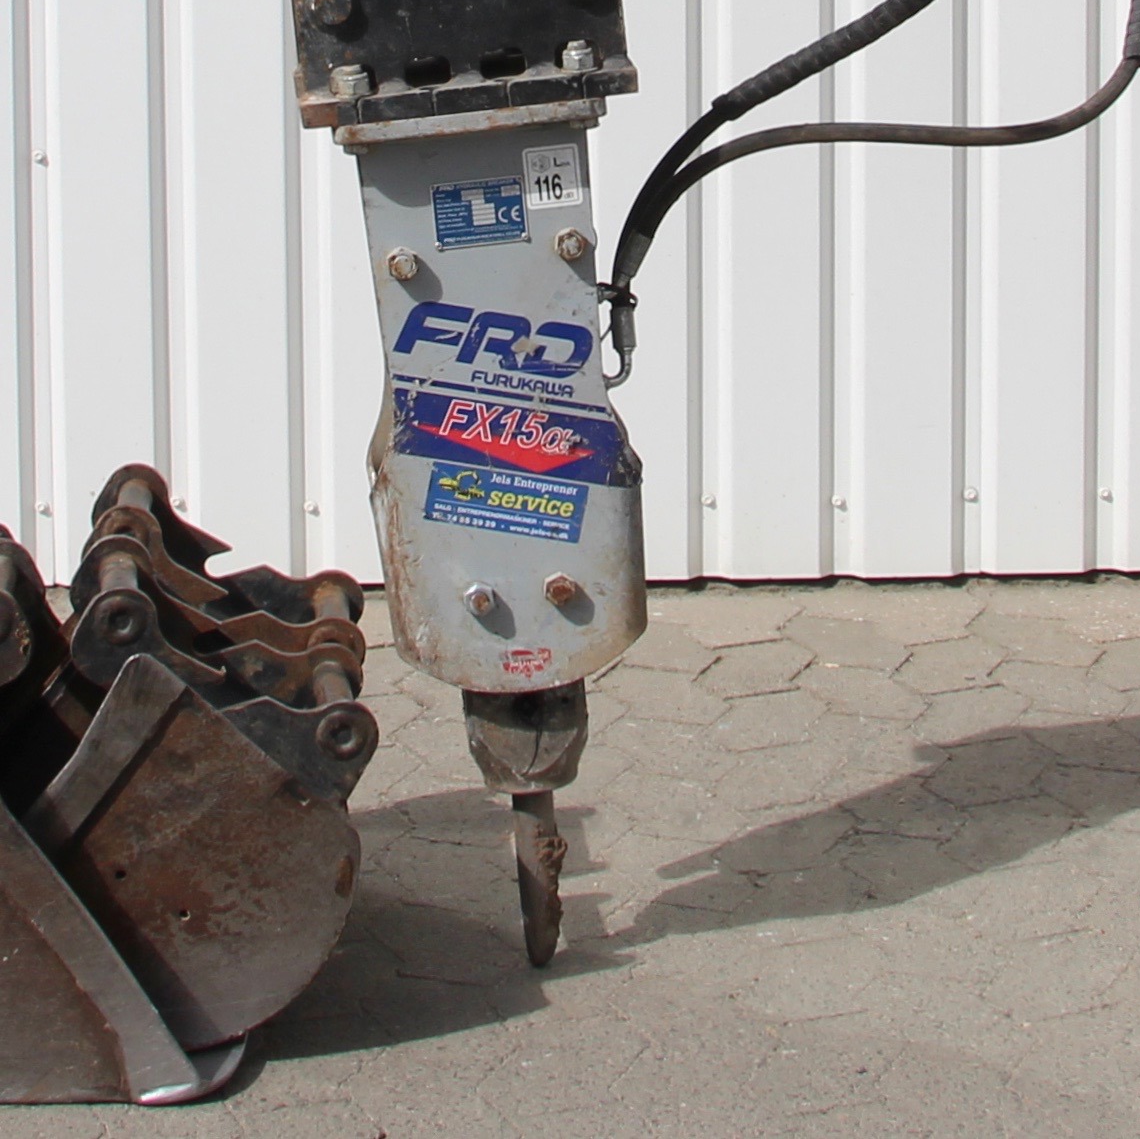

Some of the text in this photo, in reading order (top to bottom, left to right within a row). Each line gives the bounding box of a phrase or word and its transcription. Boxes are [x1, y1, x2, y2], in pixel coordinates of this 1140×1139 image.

[534, 173, 563, 202] 116
[393, 301, 594, 378] FRD
[470, 370, 578, 399] FURUKAWA
[491, 473, 579, 496] Jels Entreprenør
[487, 490, 575, 518] service
